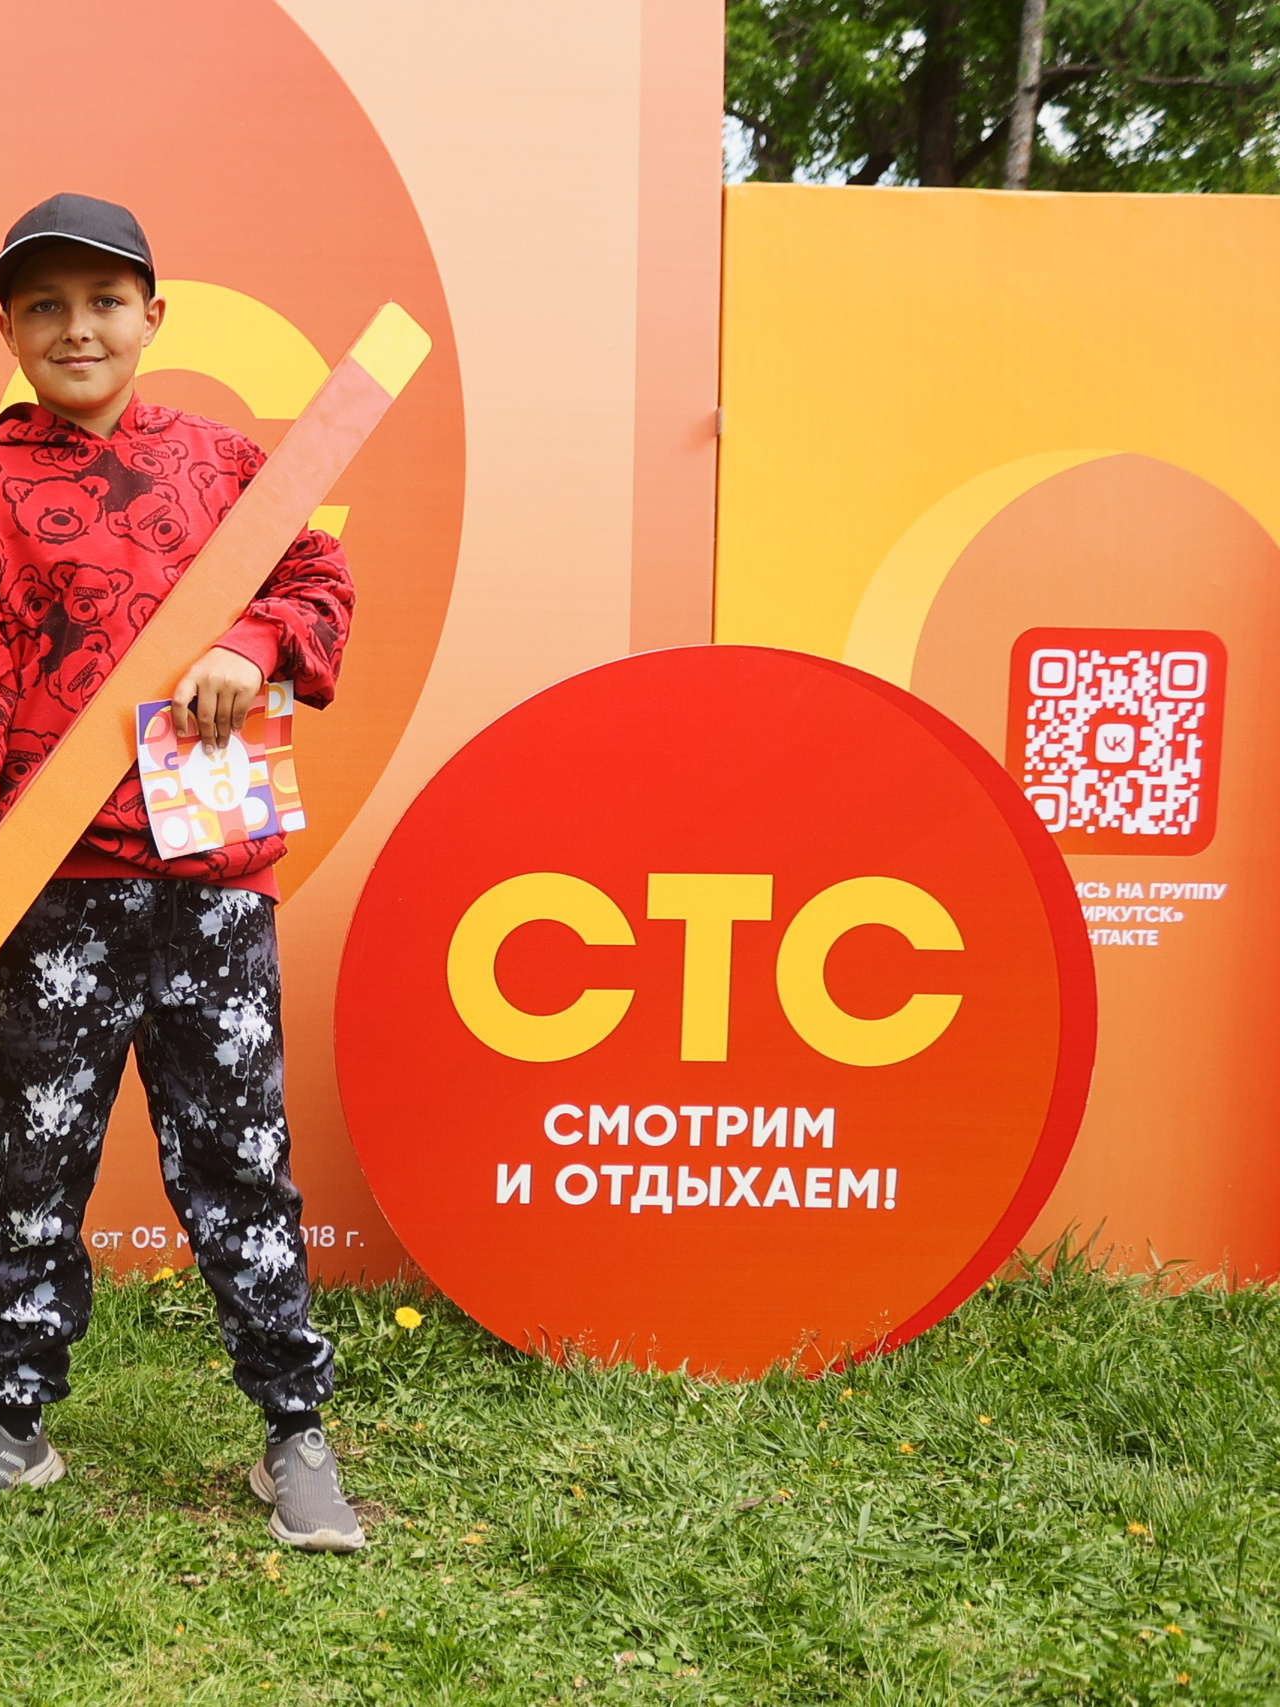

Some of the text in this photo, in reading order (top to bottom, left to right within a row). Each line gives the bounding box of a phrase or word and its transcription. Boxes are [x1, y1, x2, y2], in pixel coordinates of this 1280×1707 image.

[1115, 882, 1145, 899] НА
[1149, 882, 1228, 900] ГРУППУ
[447, 872, 965, 1067] СТС
[543, 1103, 835, 1149] СМОТРИМ
[496, 1164, 898, 1214] И ОТДЫХАЕМ!
[91, 1231, 123, 1249] от
[131, 1226, 167, 1249] 05
[346, 1231, 365, 1247] г.
